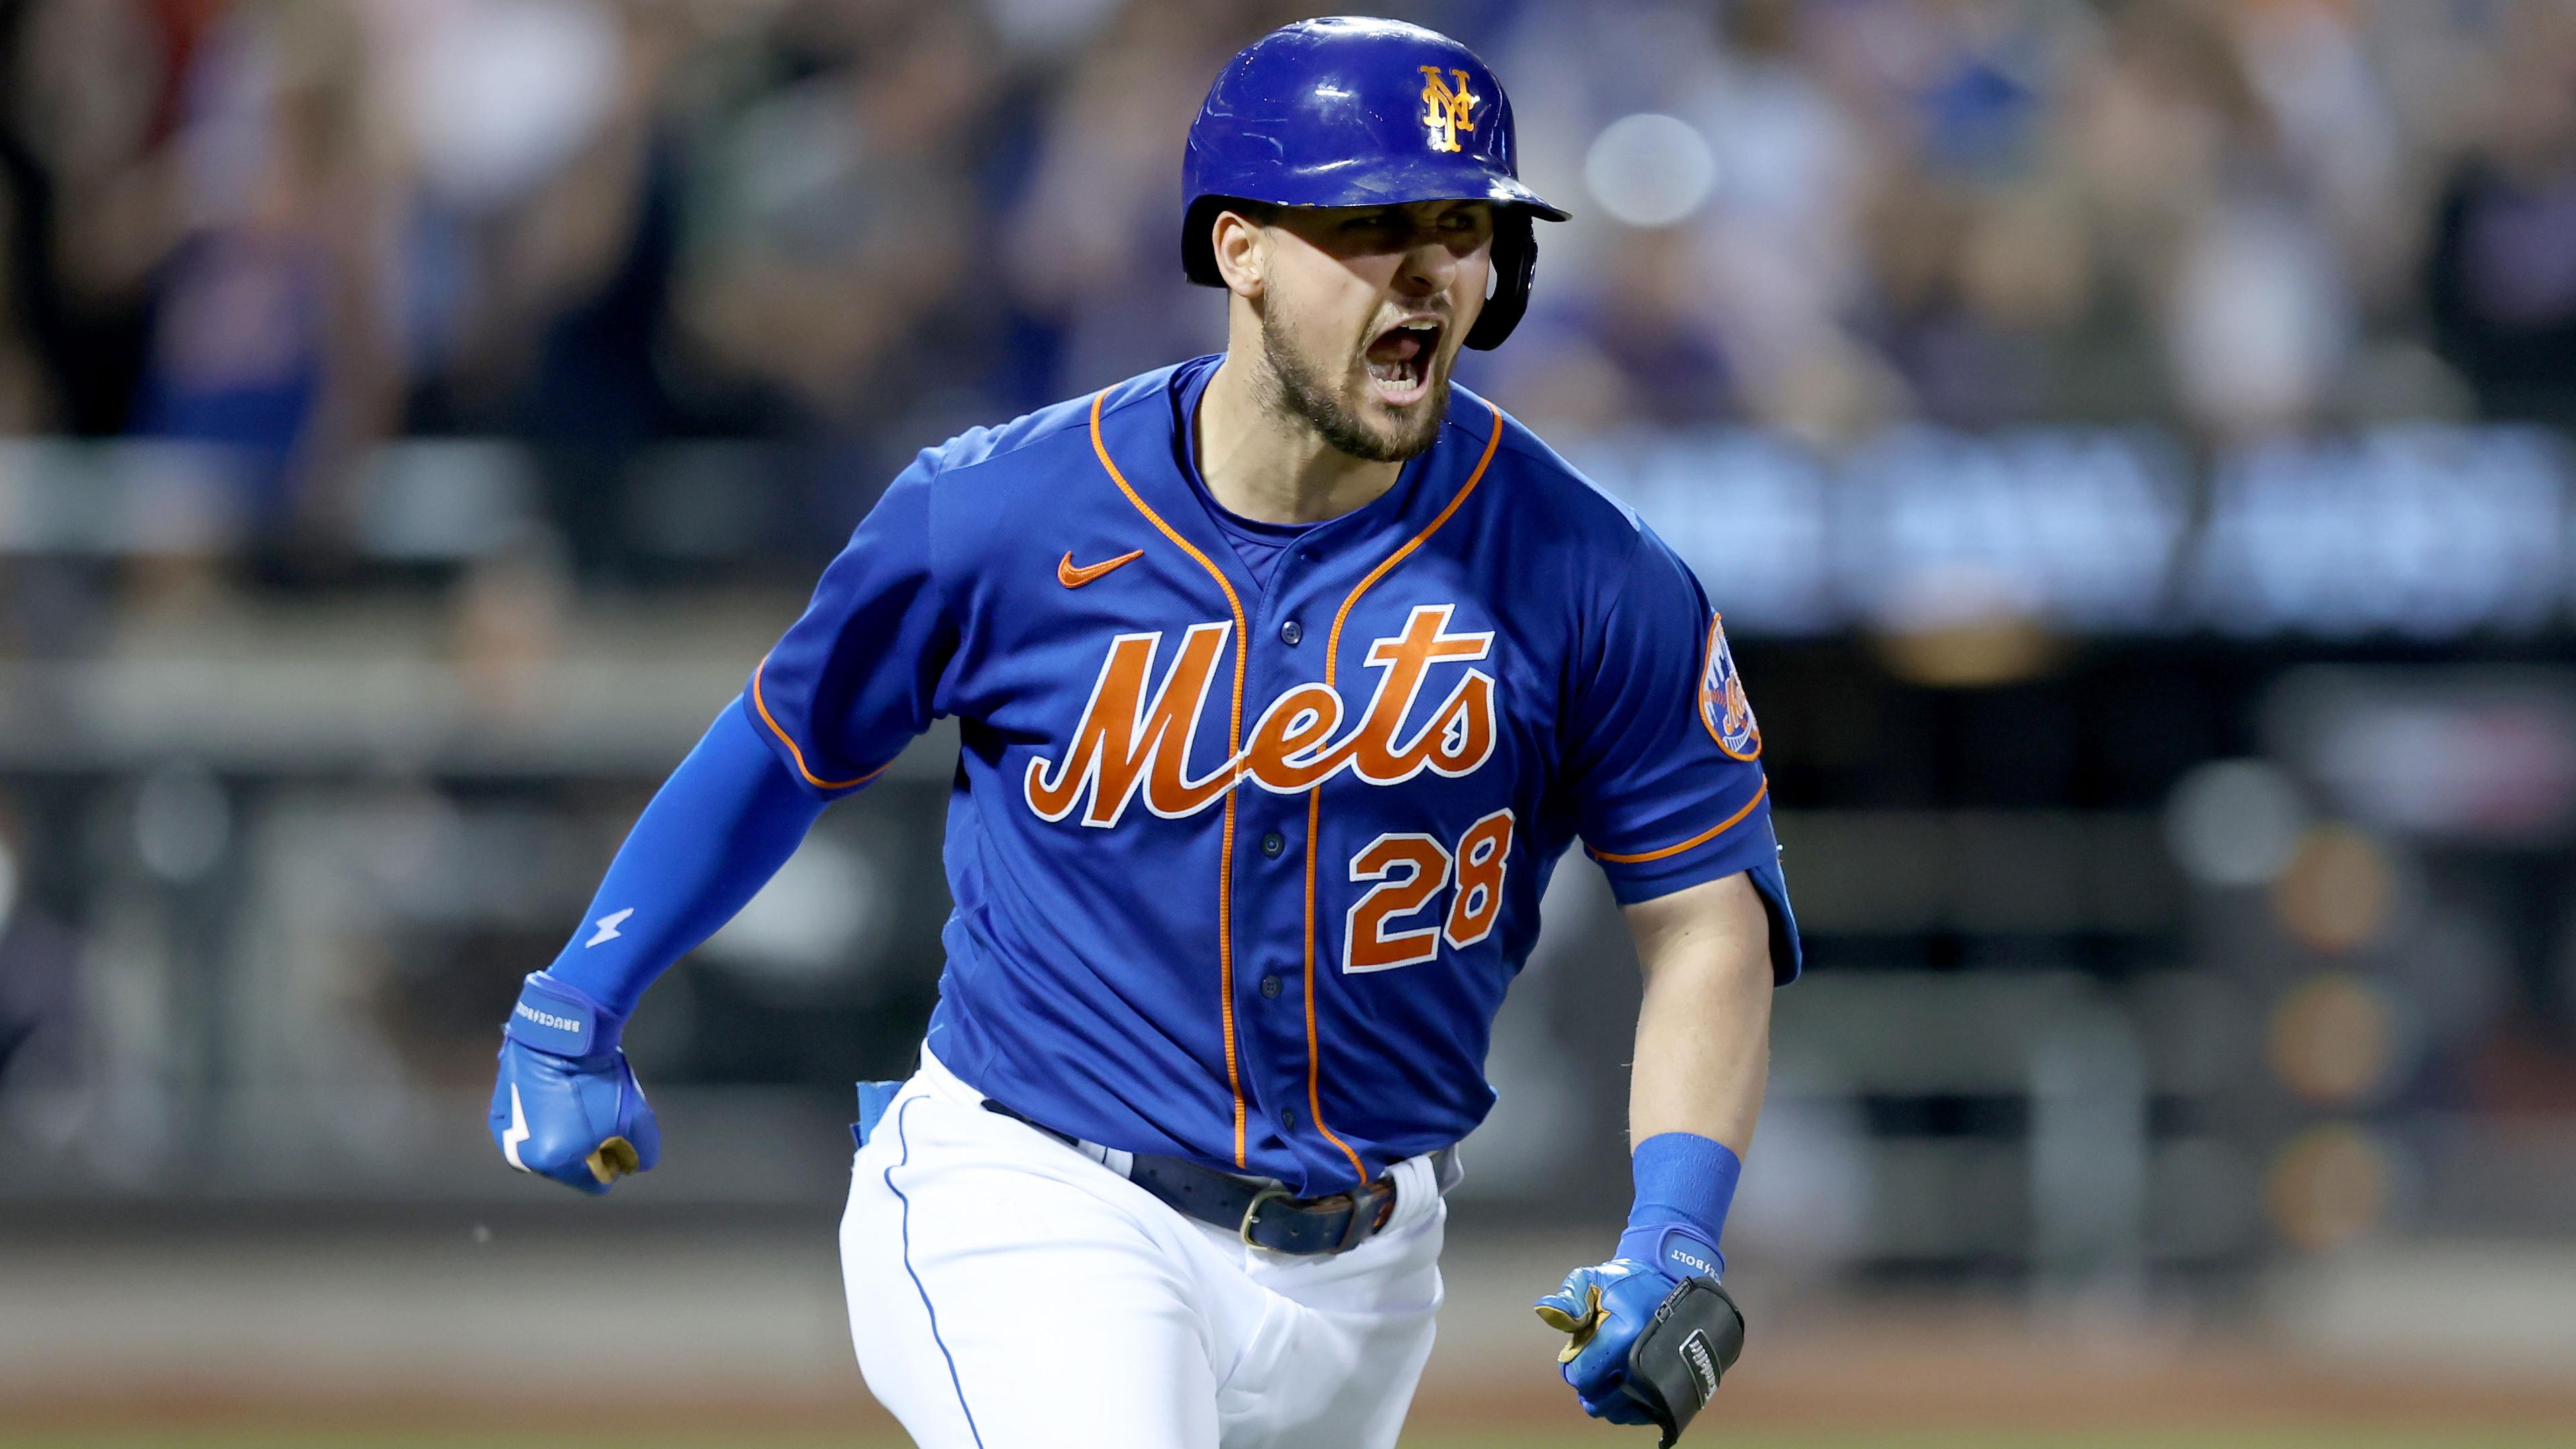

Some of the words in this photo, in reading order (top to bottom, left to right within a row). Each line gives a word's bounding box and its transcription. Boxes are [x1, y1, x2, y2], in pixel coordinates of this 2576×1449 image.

[1024, 603, 1495, 828] Mets
[1342, 807, 1517, 975] 28
[538, 1011, 580, 1033] BRUCE
[1671, 1249, 1705, 1270] BOLT
